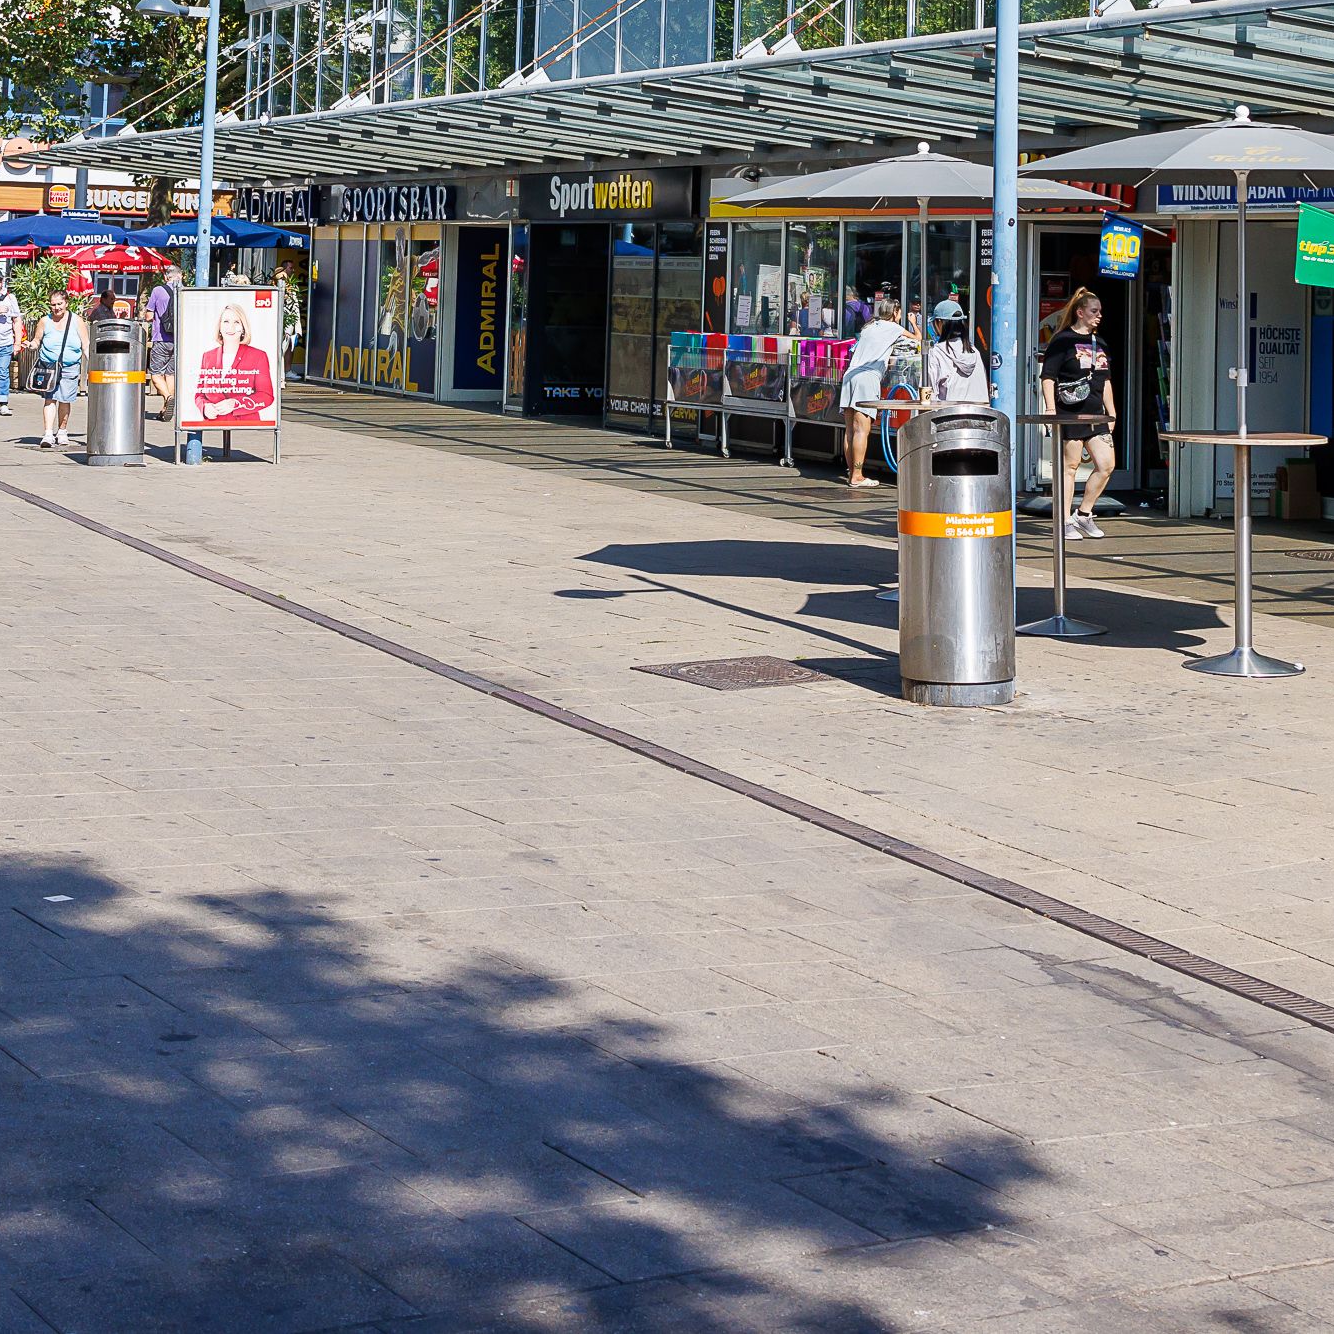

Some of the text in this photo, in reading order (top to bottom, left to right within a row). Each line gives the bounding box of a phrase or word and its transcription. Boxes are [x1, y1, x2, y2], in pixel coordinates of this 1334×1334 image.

[1208, 154, 1309, 164] Tchibo
[550, 174, 652, 218] Sportwetten
[1240, 186, 1286, 198] ABAK
[85, 189, 151, 210] BURGE
[342, 185, 447, 222] SPORTSBAR
[64, 233, 117, 245] ADMIRAL
[167, 234, 236, 246] ADMRAL
[1102, 232, 1140, 259] 100
[255, 299, 272, 308] SPÖ
[476, 242, 500, 375] ADMIRAL
[1259, 324, 1301, 341] HÖCHSTE
[1258, 341, 1301, 356] QUALITÄT
[323, 339, 418, 393] ADMIRAL
[1258, 356, 1276, 370] SEIT
[1258, 371, 1279, 384] 1954
[544, 386, 580, 398] TAKE
[610, 399, 629, 412] YOUR
[945, 516, 995, 525] Misttelefon
